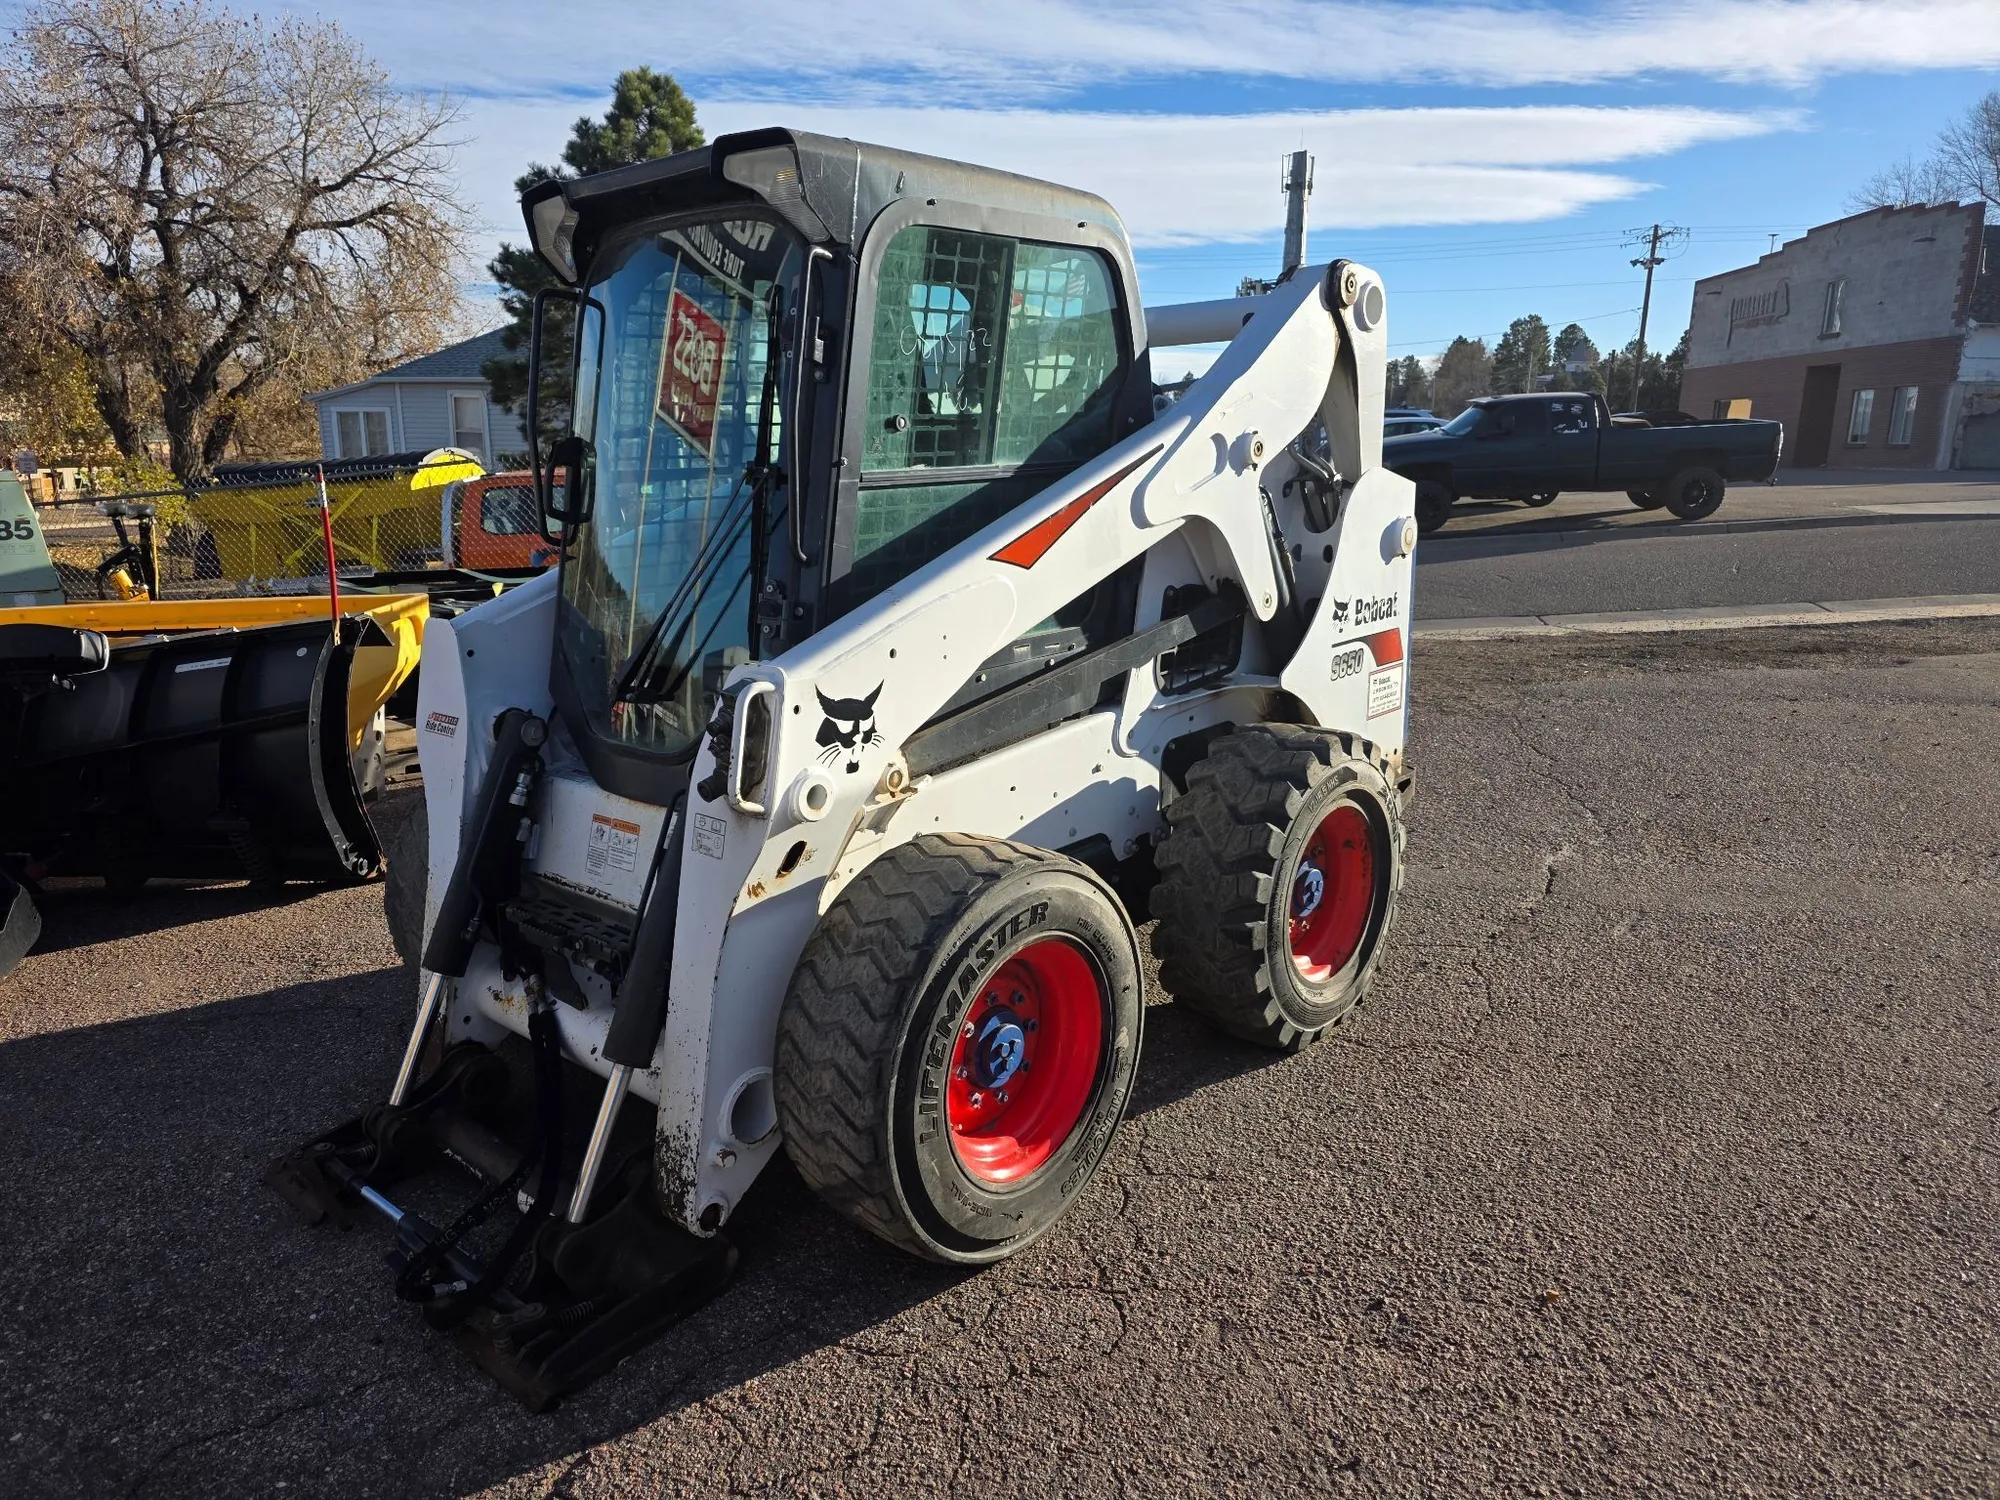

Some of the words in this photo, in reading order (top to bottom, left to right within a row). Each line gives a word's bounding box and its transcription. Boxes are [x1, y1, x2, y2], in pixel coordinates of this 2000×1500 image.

[1355, 592, 1399, 626] Bobcat
[1330, 648, 1364, 682] S650
[918, 900, 1049, 1145] LIFEMASTER
[1060, 1087, 1126, 1198] HERCULES
